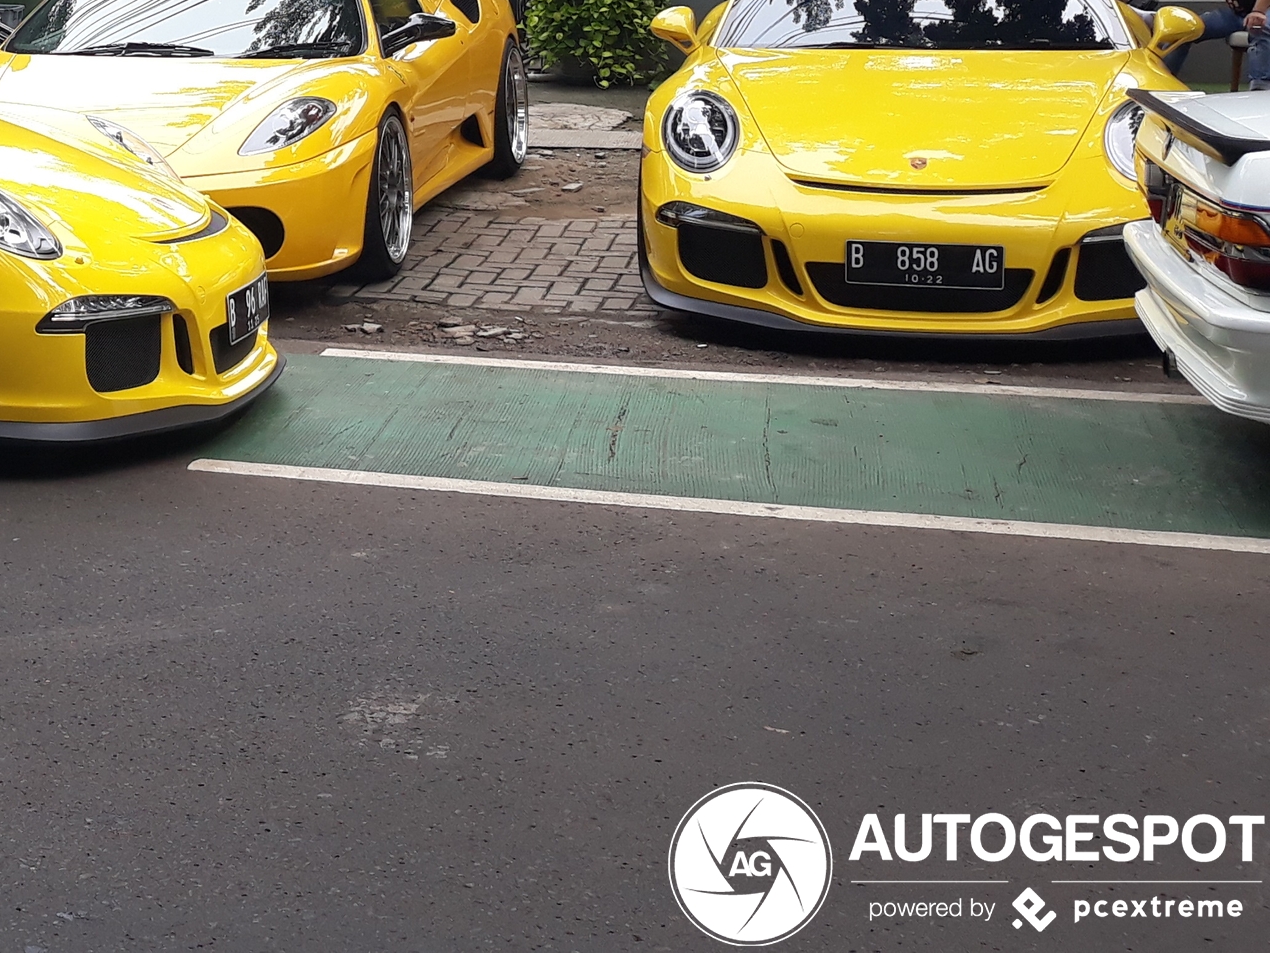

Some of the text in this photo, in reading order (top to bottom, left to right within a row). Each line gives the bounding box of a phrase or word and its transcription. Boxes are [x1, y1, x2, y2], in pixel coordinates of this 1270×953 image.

[851, 243, 998, 274] B 858 AG
[230, 298, 235, 327] B
[246, 287, 255, 318] 96
